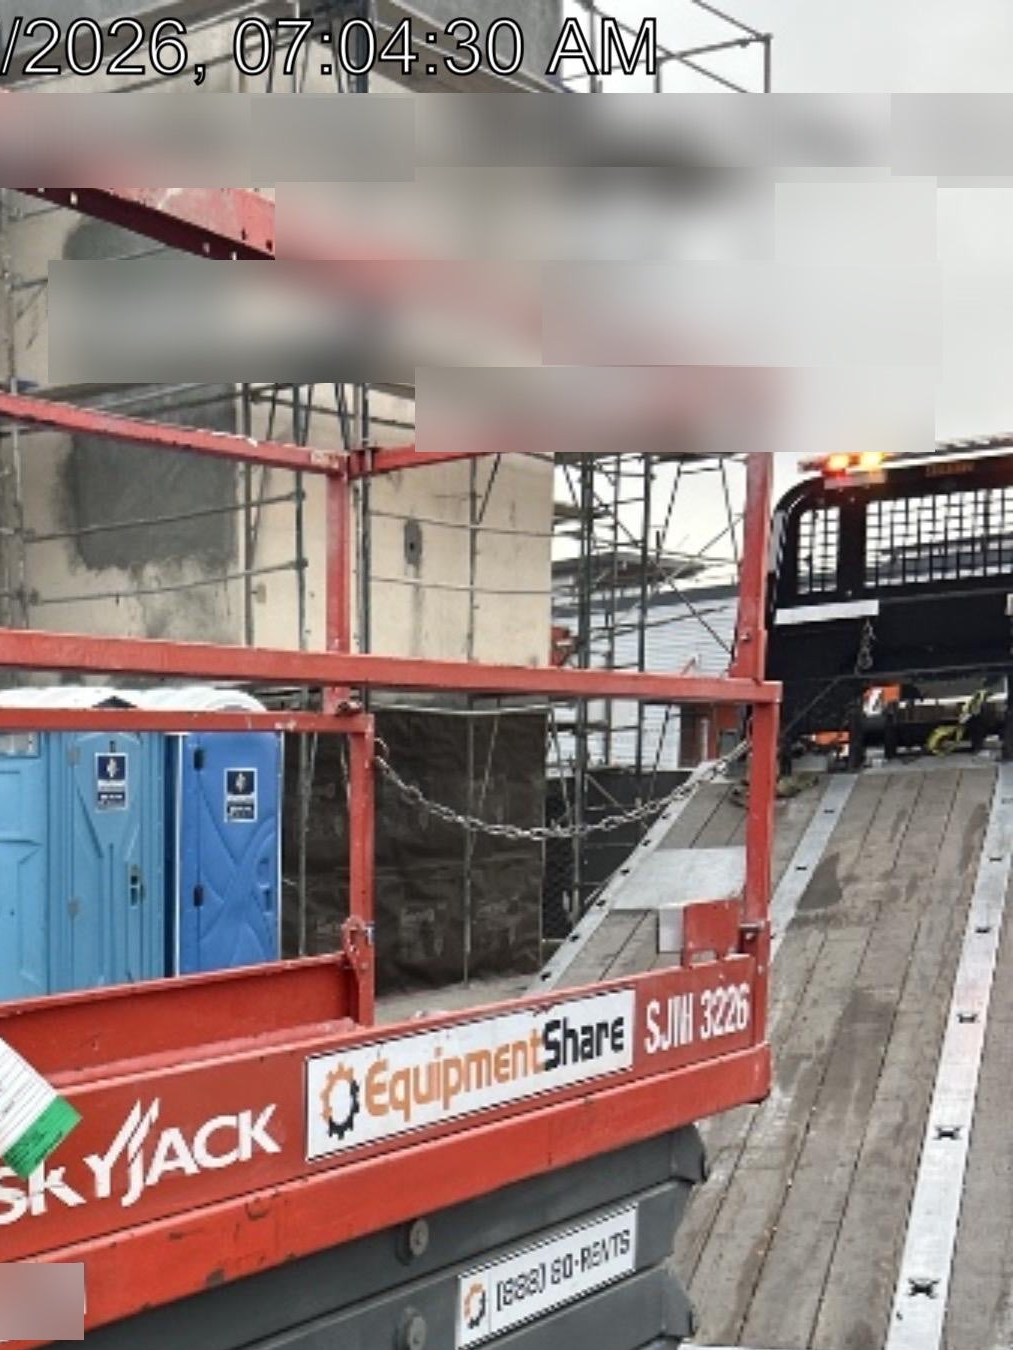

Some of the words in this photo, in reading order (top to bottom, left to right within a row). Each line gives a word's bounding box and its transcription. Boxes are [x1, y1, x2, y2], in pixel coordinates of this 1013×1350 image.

[700, 982, 750, 1040] 3226
[365, 1016, 625, 1122] EquipmentShare
[496, 1262, 546, 1311] (888)
[550, 1228, 631, 1286] 80-RENTS
